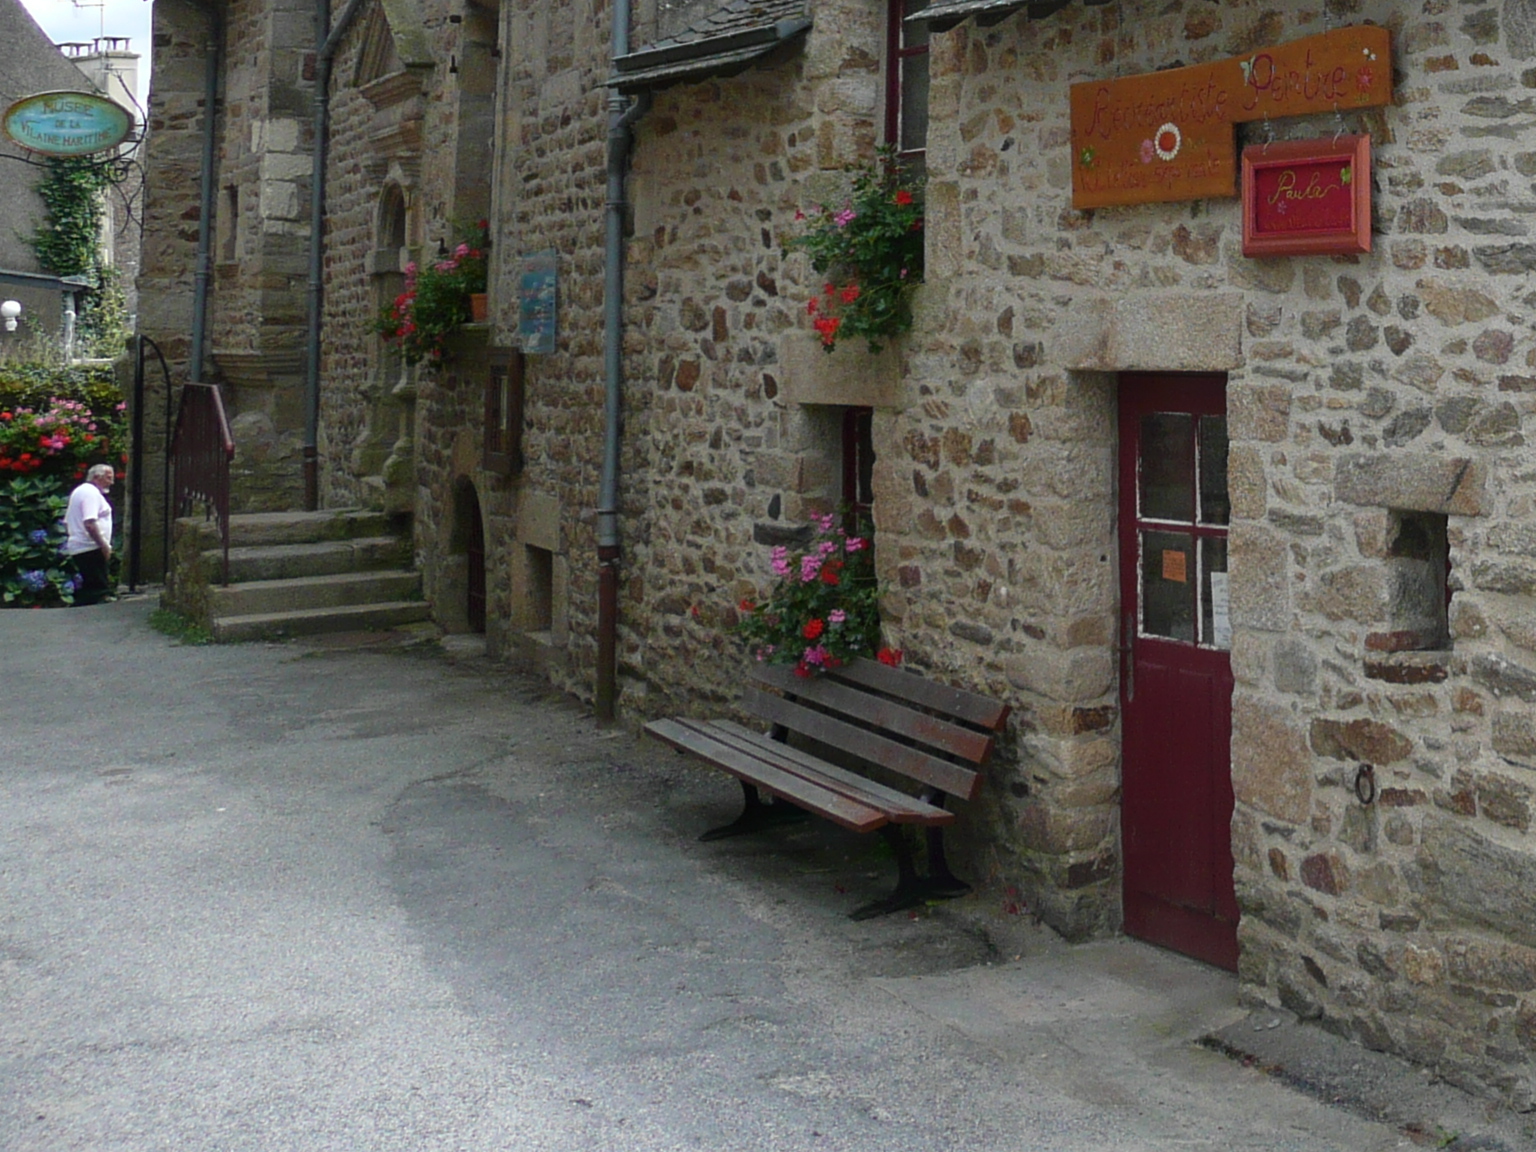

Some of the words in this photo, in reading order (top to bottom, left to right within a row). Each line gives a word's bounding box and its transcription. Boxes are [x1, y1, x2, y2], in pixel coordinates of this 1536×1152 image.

[1243, 49, 1348, 111] Peintre
[21, 120, 60, 145] VILAINE
[62, 128, 112, 146] MARITIME
[55, 120, 65, 128] DE
[70, 120, 81, 128] LA
